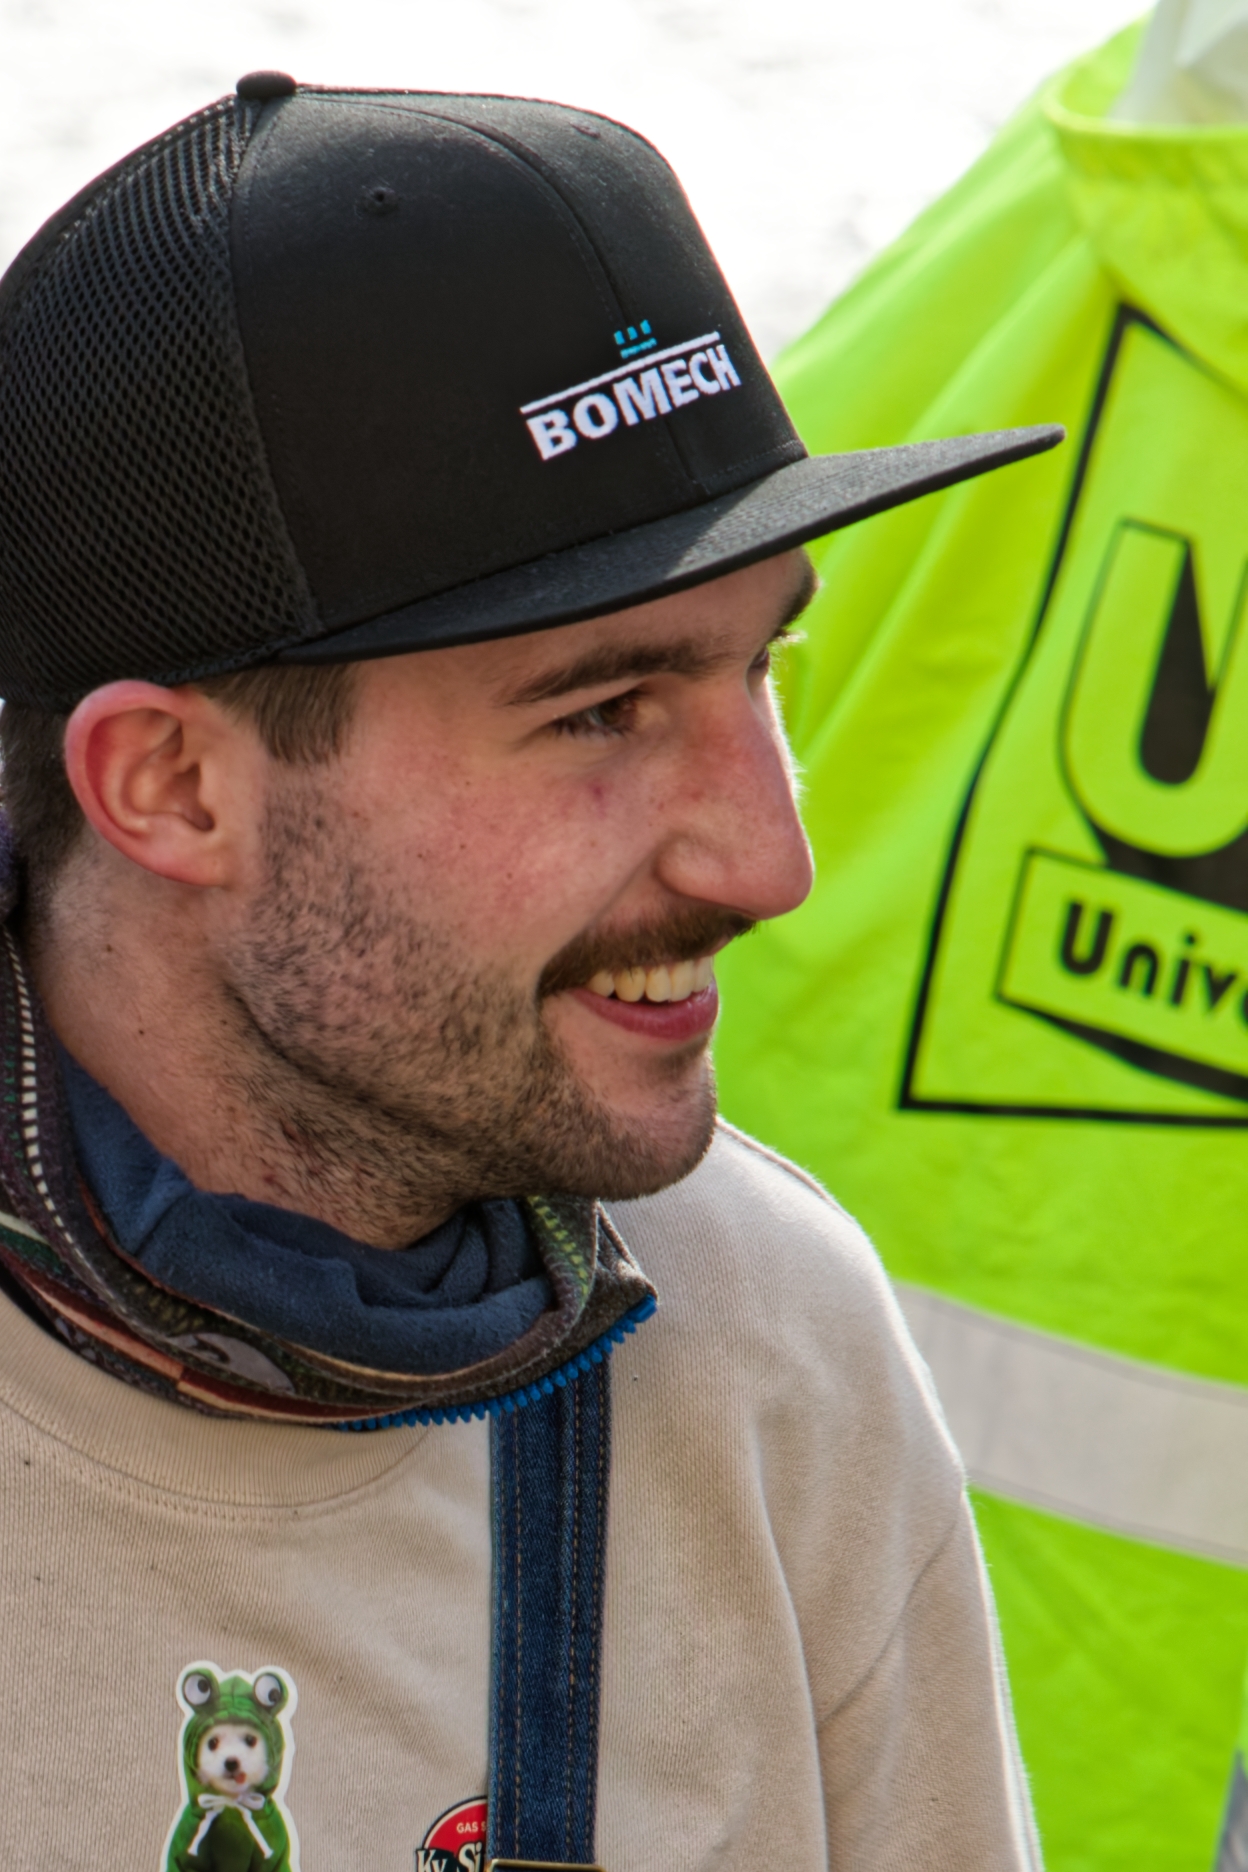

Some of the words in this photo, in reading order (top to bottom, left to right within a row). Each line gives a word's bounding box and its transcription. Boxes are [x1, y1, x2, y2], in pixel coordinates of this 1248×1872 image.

[526, 344, 741, 461] BOMECH
[1061, 901, 1248, 1030] Univ
[456, 1821, 479, 1834] GAS
